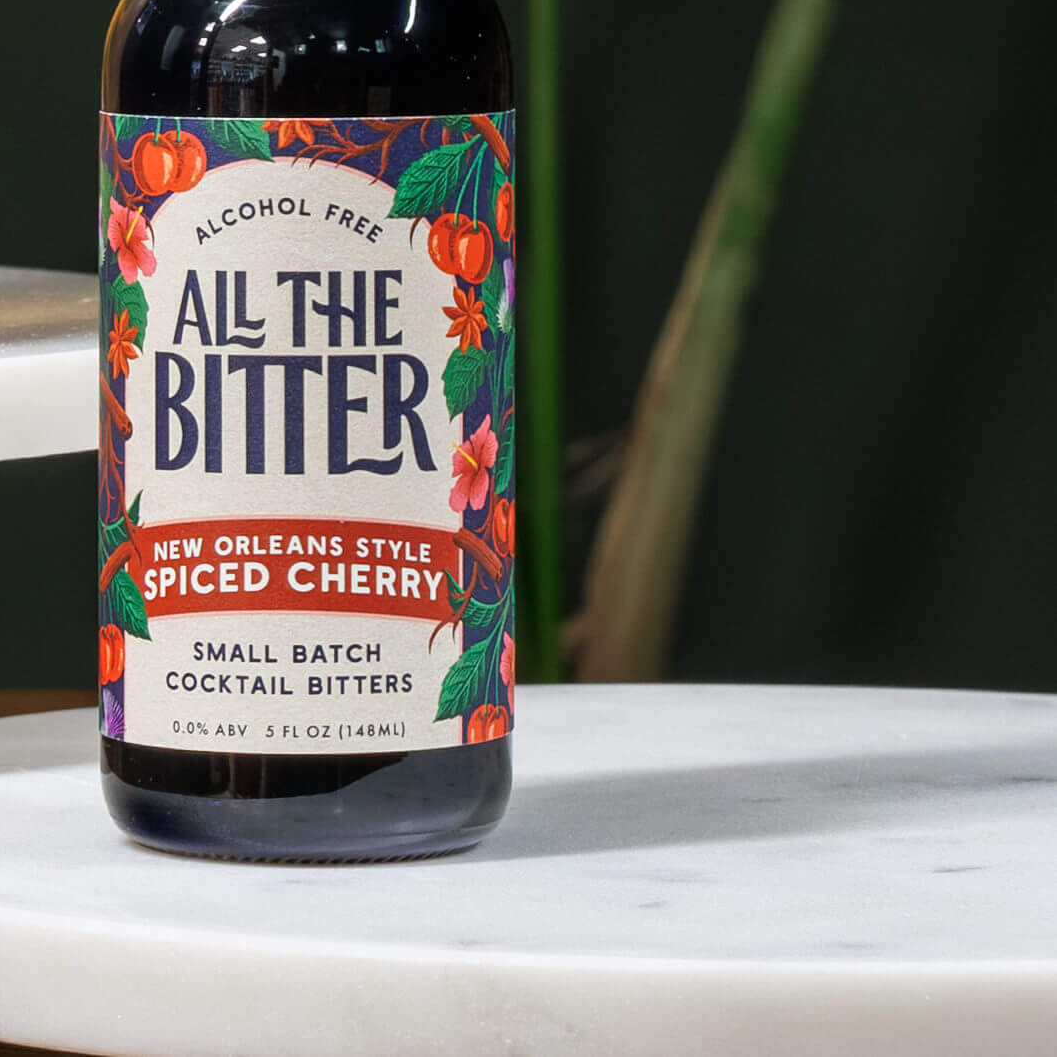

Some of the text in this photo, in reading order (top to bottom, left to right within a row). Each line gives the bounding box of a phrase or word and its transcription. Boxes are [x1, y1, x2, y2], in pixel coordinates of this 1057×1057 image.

[195, 197, 383, 245] ALCOHOL FREE
[173, 269, 403, 349] ALL THE
[154, 350, 439, 475] BITTER
[153, 535, 431, 563] NEW ORLEANS STYLE
[144, 561, 444, 601] SPICED CHERRY
[193, 642, 382, 664] SMALL BATCH
[165, 671, 413, 696] COCKTAIL BITTERS
[172, 720, 406, 740] 0.0% ABV 5 FL OZ (148ML)
